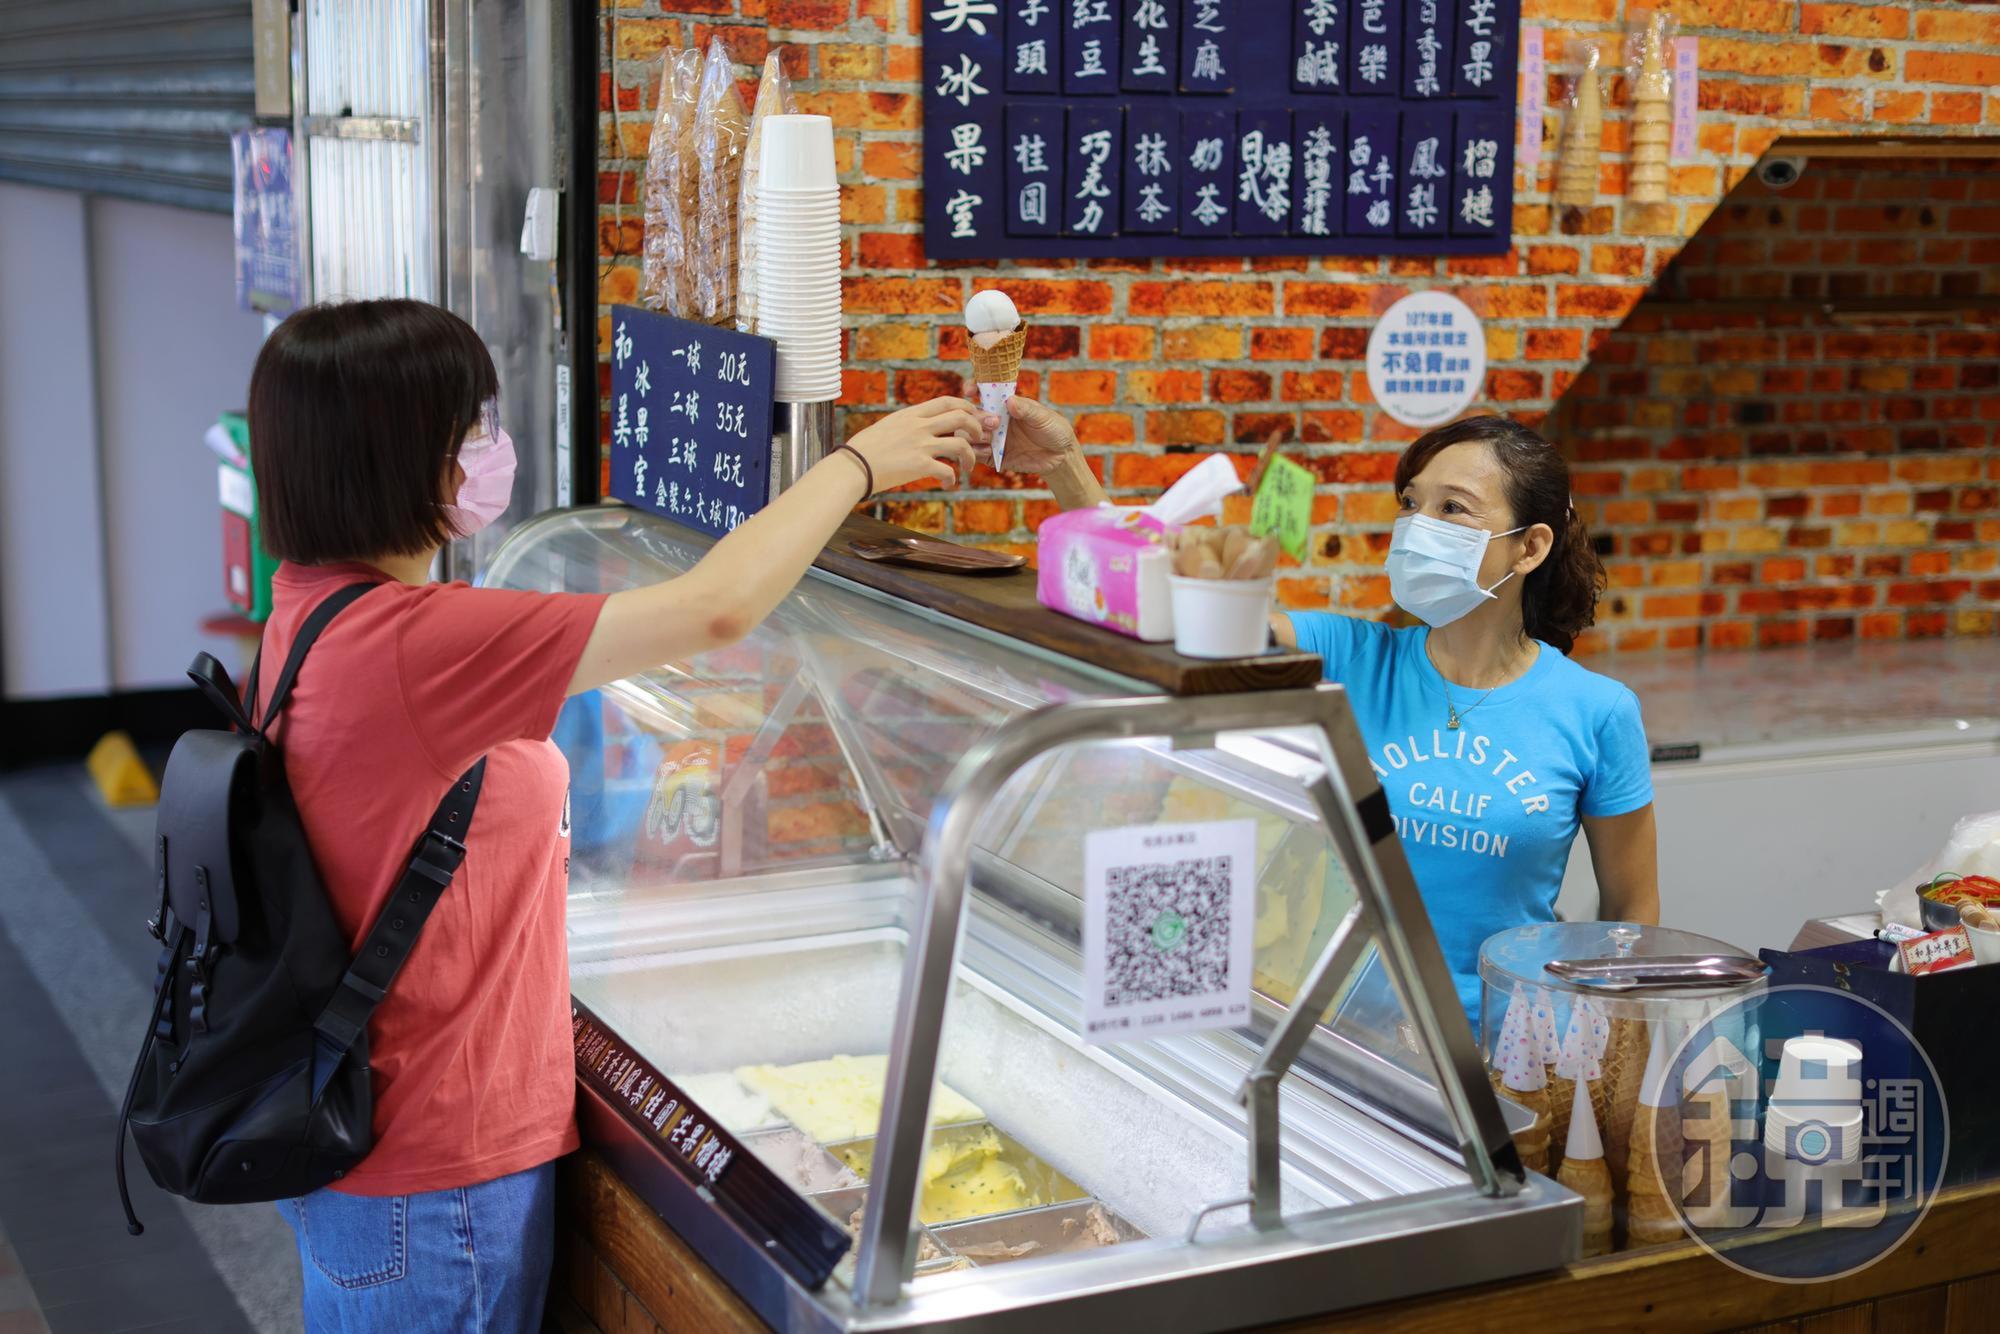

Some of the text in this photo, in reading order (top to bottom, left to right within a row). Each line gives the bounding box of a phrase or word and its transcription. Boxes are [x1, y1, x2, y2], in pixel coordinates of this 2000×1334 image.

[1073, 0, 1111, 77] 紅豆
[1193, 0, 1225, 80] 芝麻
[1359, 0, 1392, 83] 芭樂
[1463, 0, 1495, 86] 芒果
[1014, 135, 1048, 224] 桂圓
[1074, 131, 1111, 232] 巧克力
[1135, 134, 1170, 222] 抹茶
[1190, 139, 1226, 225] 奶茶
[1239, 131, 1265, 207] 日式
[1407, 138, 1445, 227] 鳳梨
[1461, 140, 1498, 226] 榴槤
[671, 340, 750, 386] 一球 20元
[669, 390, 748, 438] 二球 35元
[668, 437, 745, 488] 三球 45元
[1409, 782, 1492, 818] CALIF
